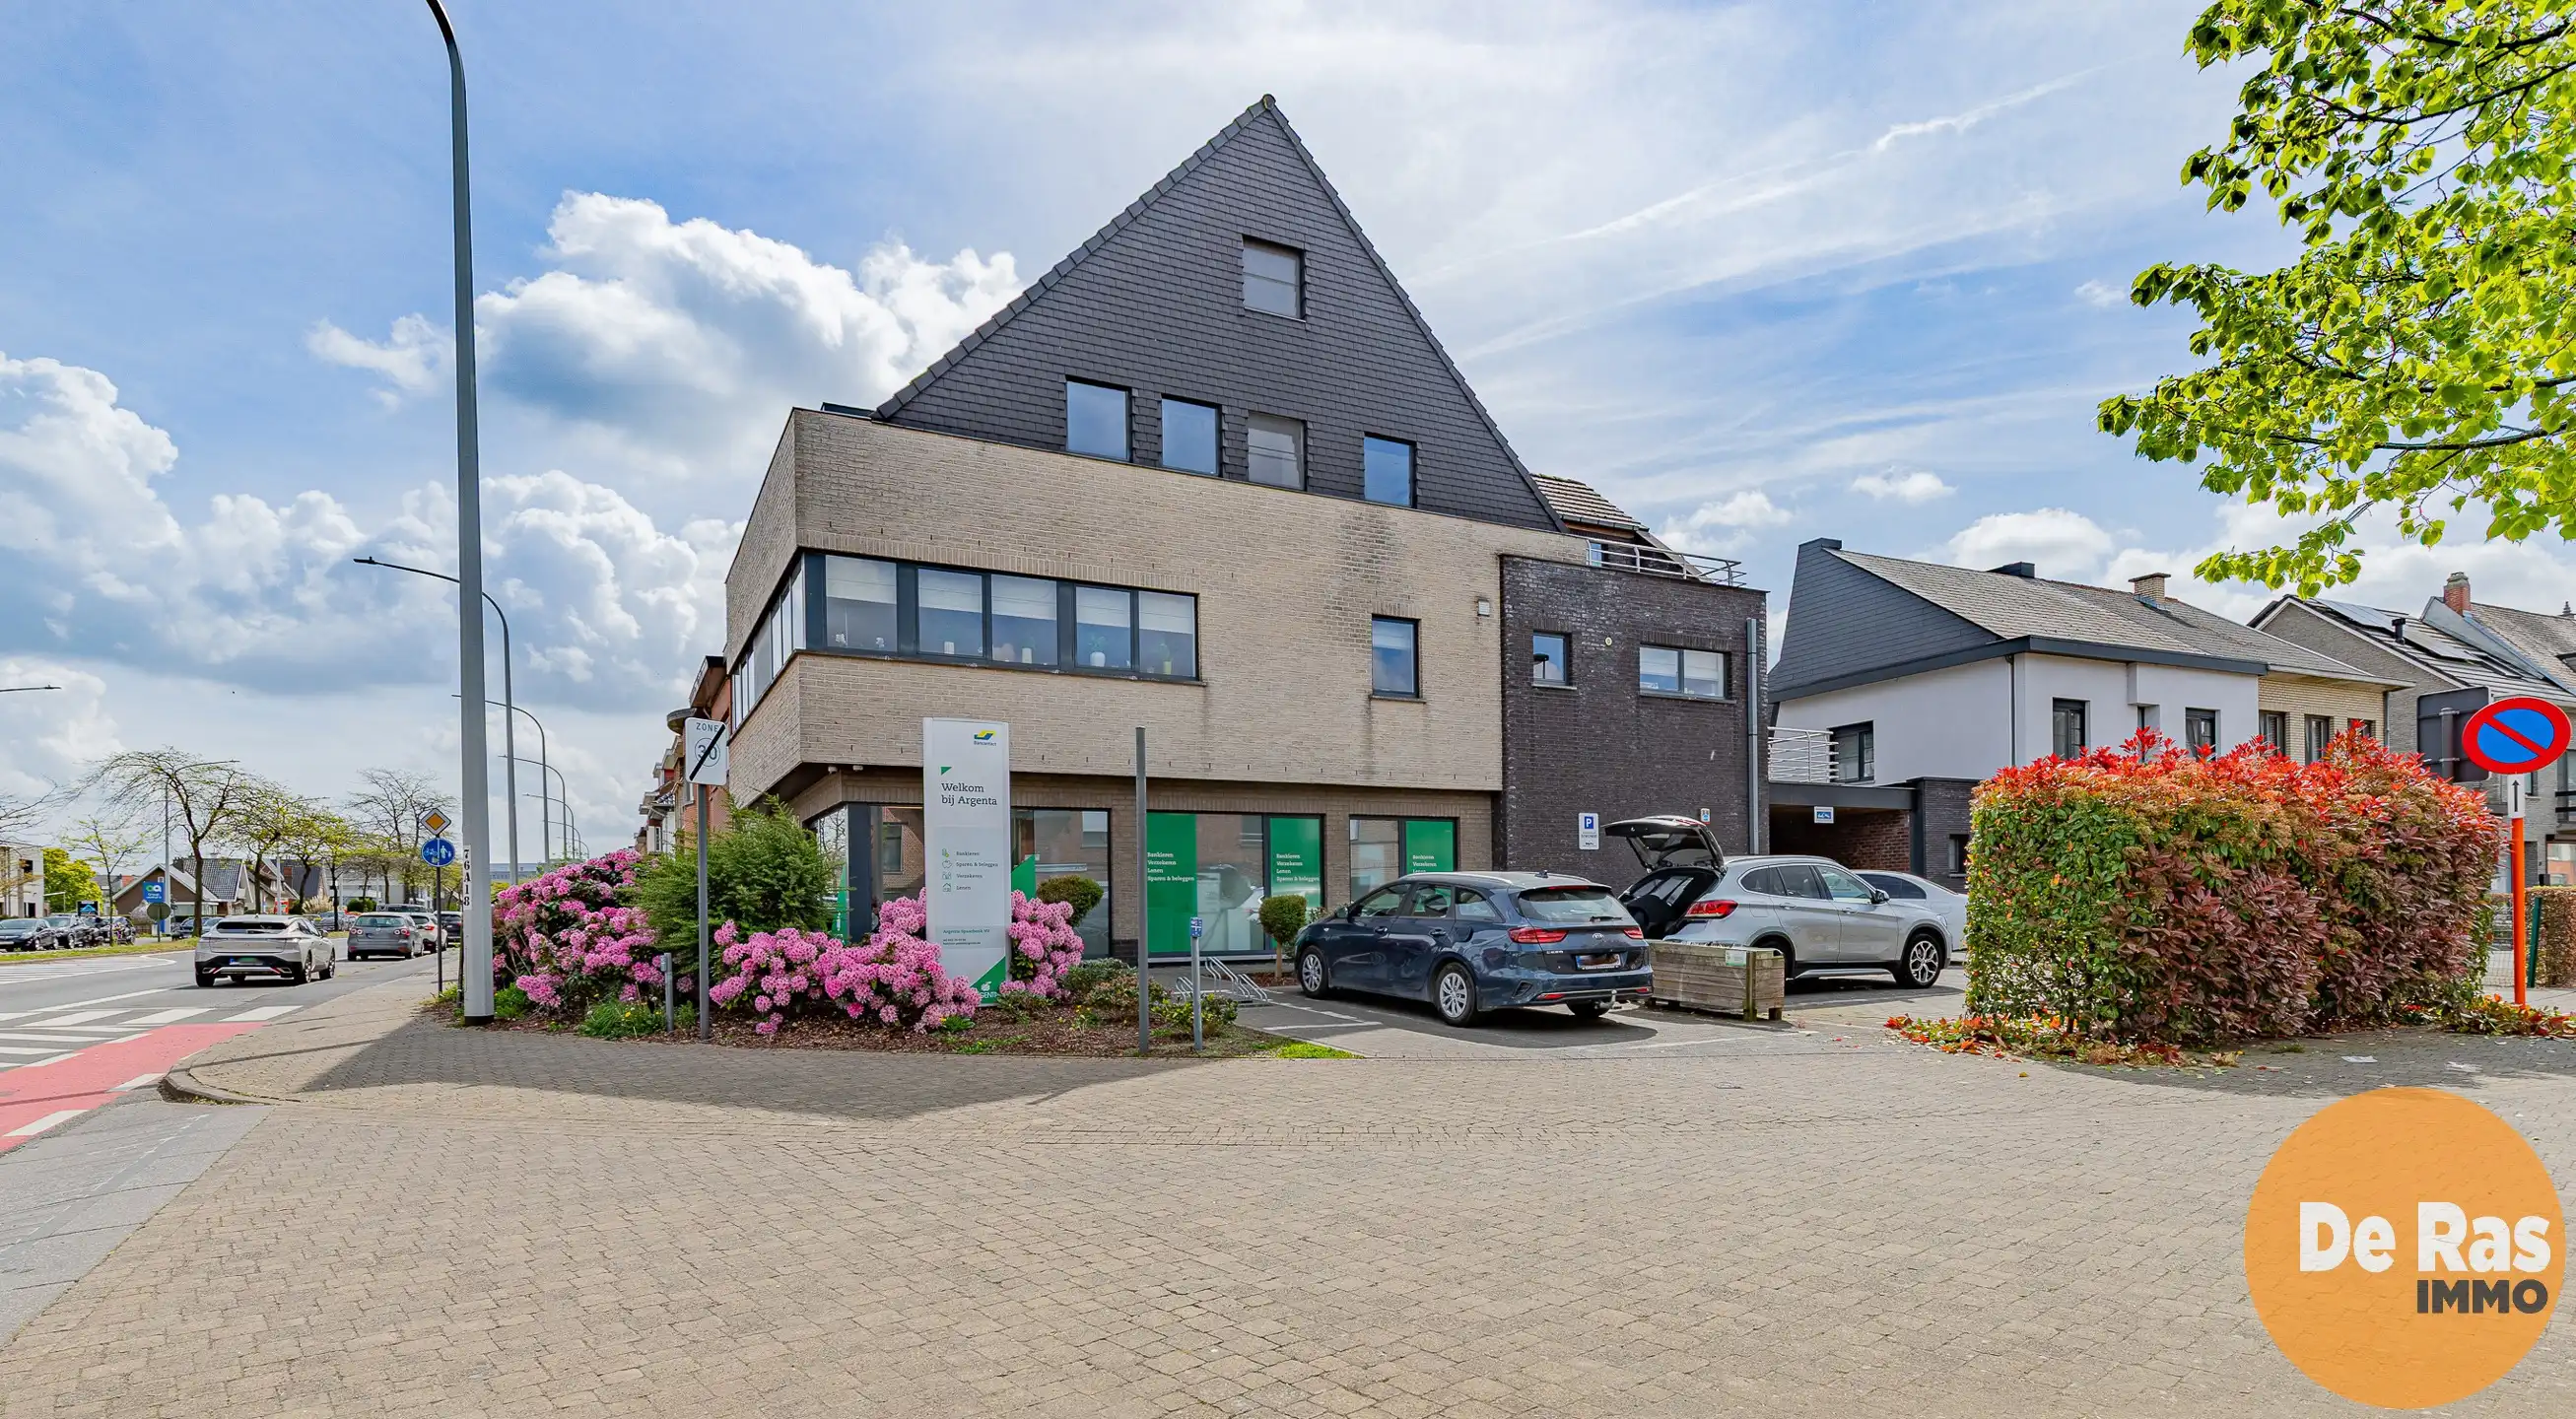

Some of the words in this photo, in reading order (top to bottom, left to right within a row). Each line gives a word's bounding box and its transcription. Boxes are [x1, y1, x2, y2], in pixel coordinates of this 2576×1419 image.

[696, 722, 719, 732] ZONE
[698, 744, 717, 761] 30
[941, 782, 984, 793] Welkom
[941, 794, 955, 807] bij
[957, 795, 998, 808] Argenta
